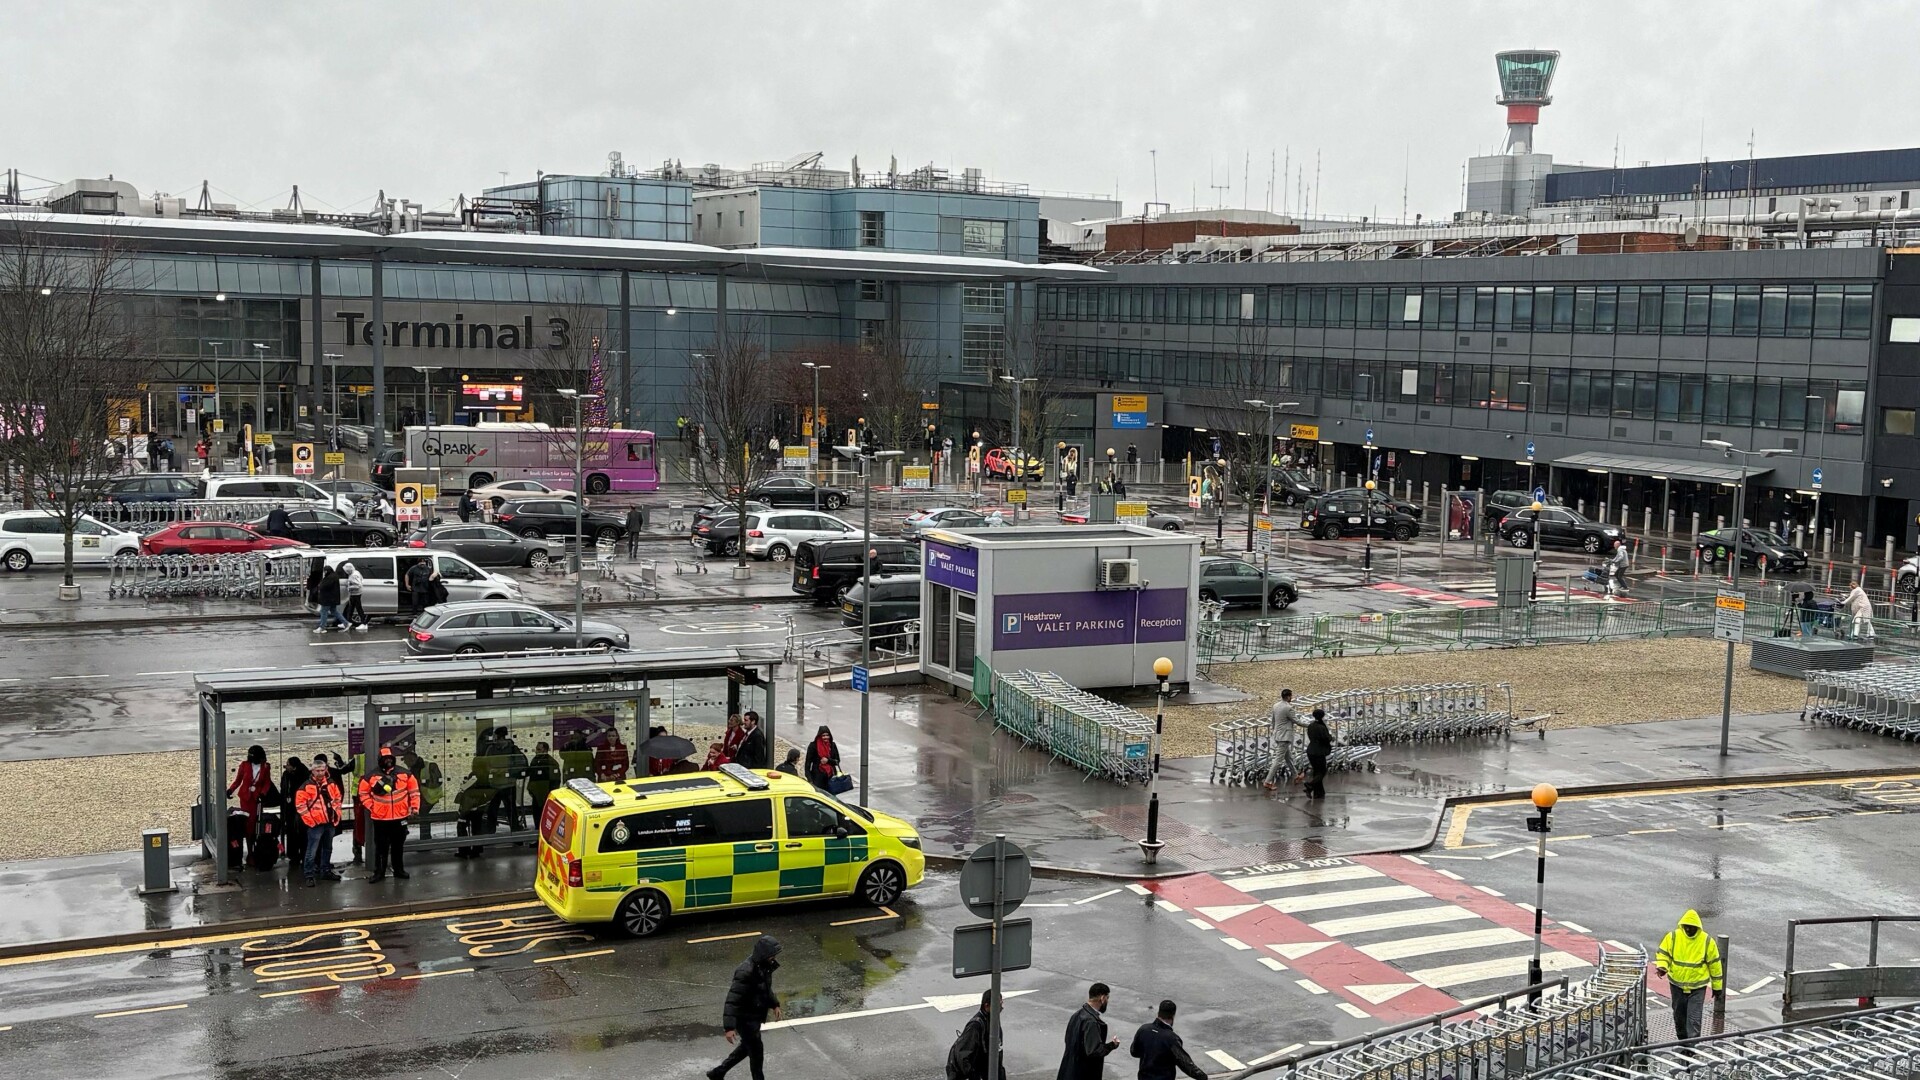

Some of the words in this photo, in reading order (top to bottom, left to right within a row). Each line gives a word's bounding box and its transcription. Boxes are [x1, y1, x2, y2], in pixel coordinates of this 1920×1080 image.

[337, 311, 533, 350] Terminal
[548, 317, 571, 349] 3
[443, 443, 477, 455] PARK
[941, 561, 955, 571] VALET
[955, 564, 975, 577] PARKING
[1023, 612, 1062, 621] Heathrow
[1140, 617, 1182, 628] Reception
[1036, 622, 1071, 632] VALET
[1075, 619, 1125, 630] PARKING
[676, 819, 691, 827] NHS
[1243, 862, 1301, 875] RIGHT
[1300, 856, 1358, 869] LOOK
[241, 929, 396, 983] STOP
